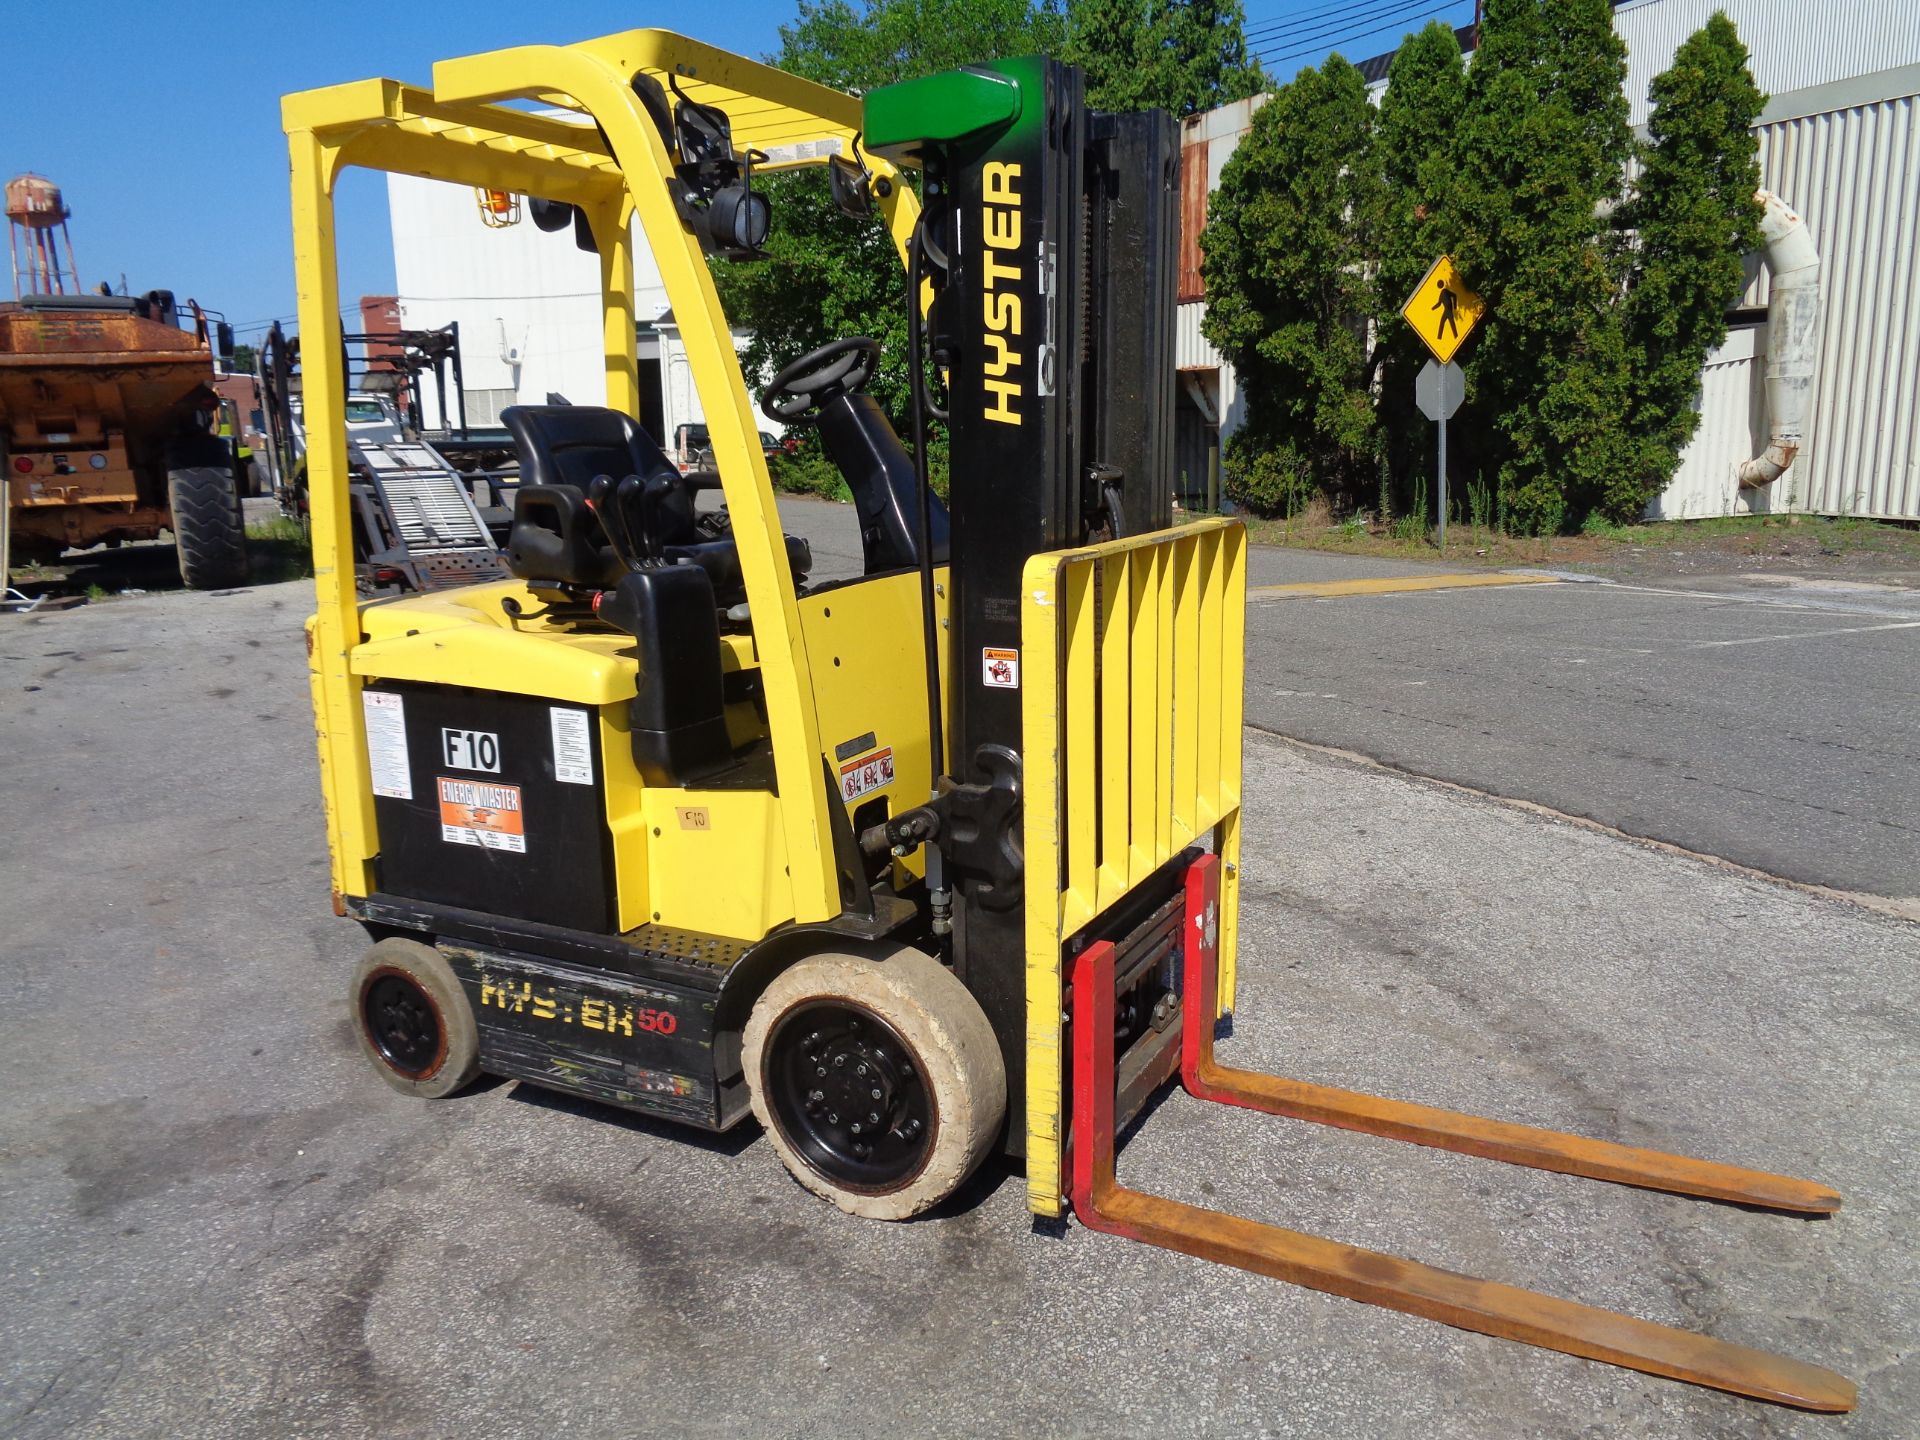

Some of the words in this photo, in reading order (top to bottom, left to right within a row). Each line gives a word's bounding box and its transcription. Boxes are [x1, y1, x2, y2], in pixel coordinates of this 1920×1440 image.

[983, 161, 1022, 426] HYSTER
[445, 730, 497, 770] F10
[441, 781, 480, 807] ENERGY
[480, 786, 519, 812] MASTER
[481, 974, 633, 1037] HYSER
[637, 1008, 677, 1034] 50
